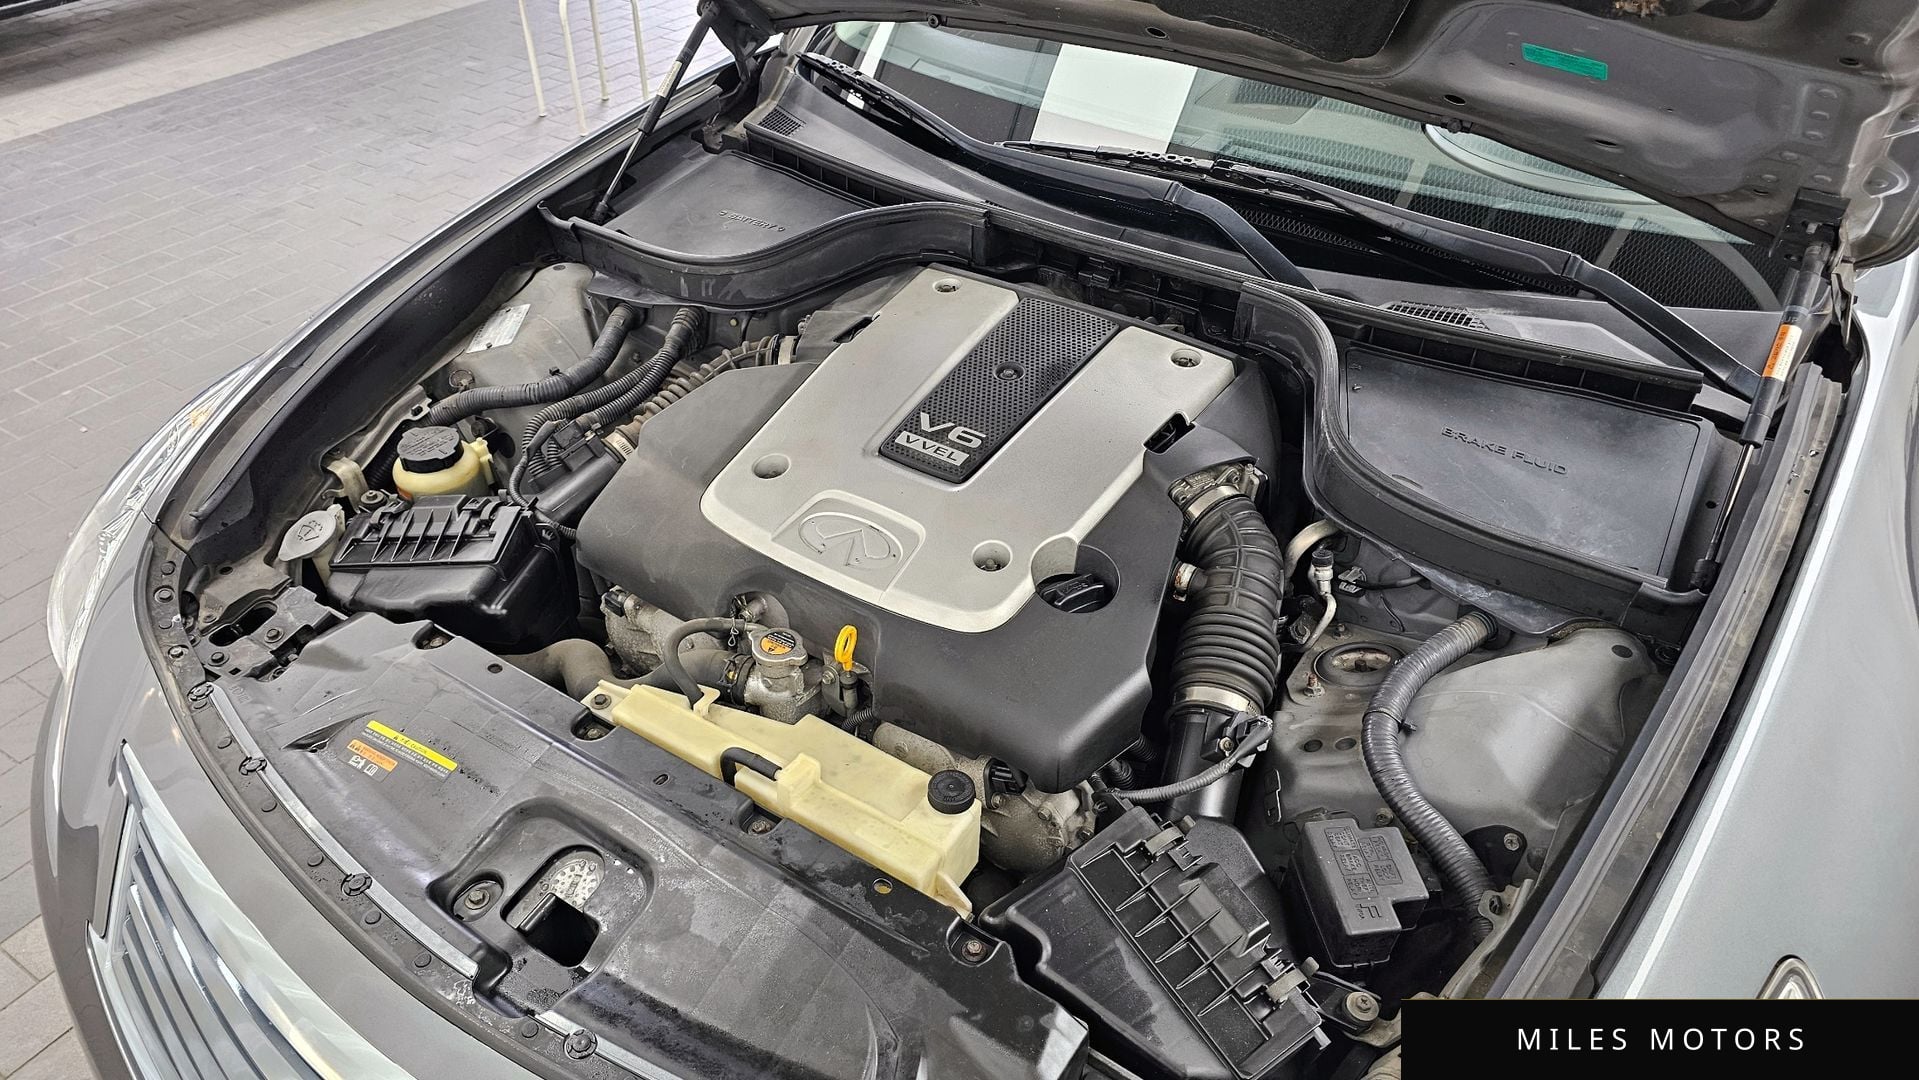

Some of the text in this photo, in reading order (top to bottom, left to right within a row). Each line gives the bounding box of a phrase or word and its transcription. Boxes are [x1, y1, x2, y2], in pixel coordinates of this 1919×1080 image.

[905, 434, 958, 462] VVEL
[920, 411, 987, 449] V6
[1441, 426, 1568, 475] BRAKE FLUID
